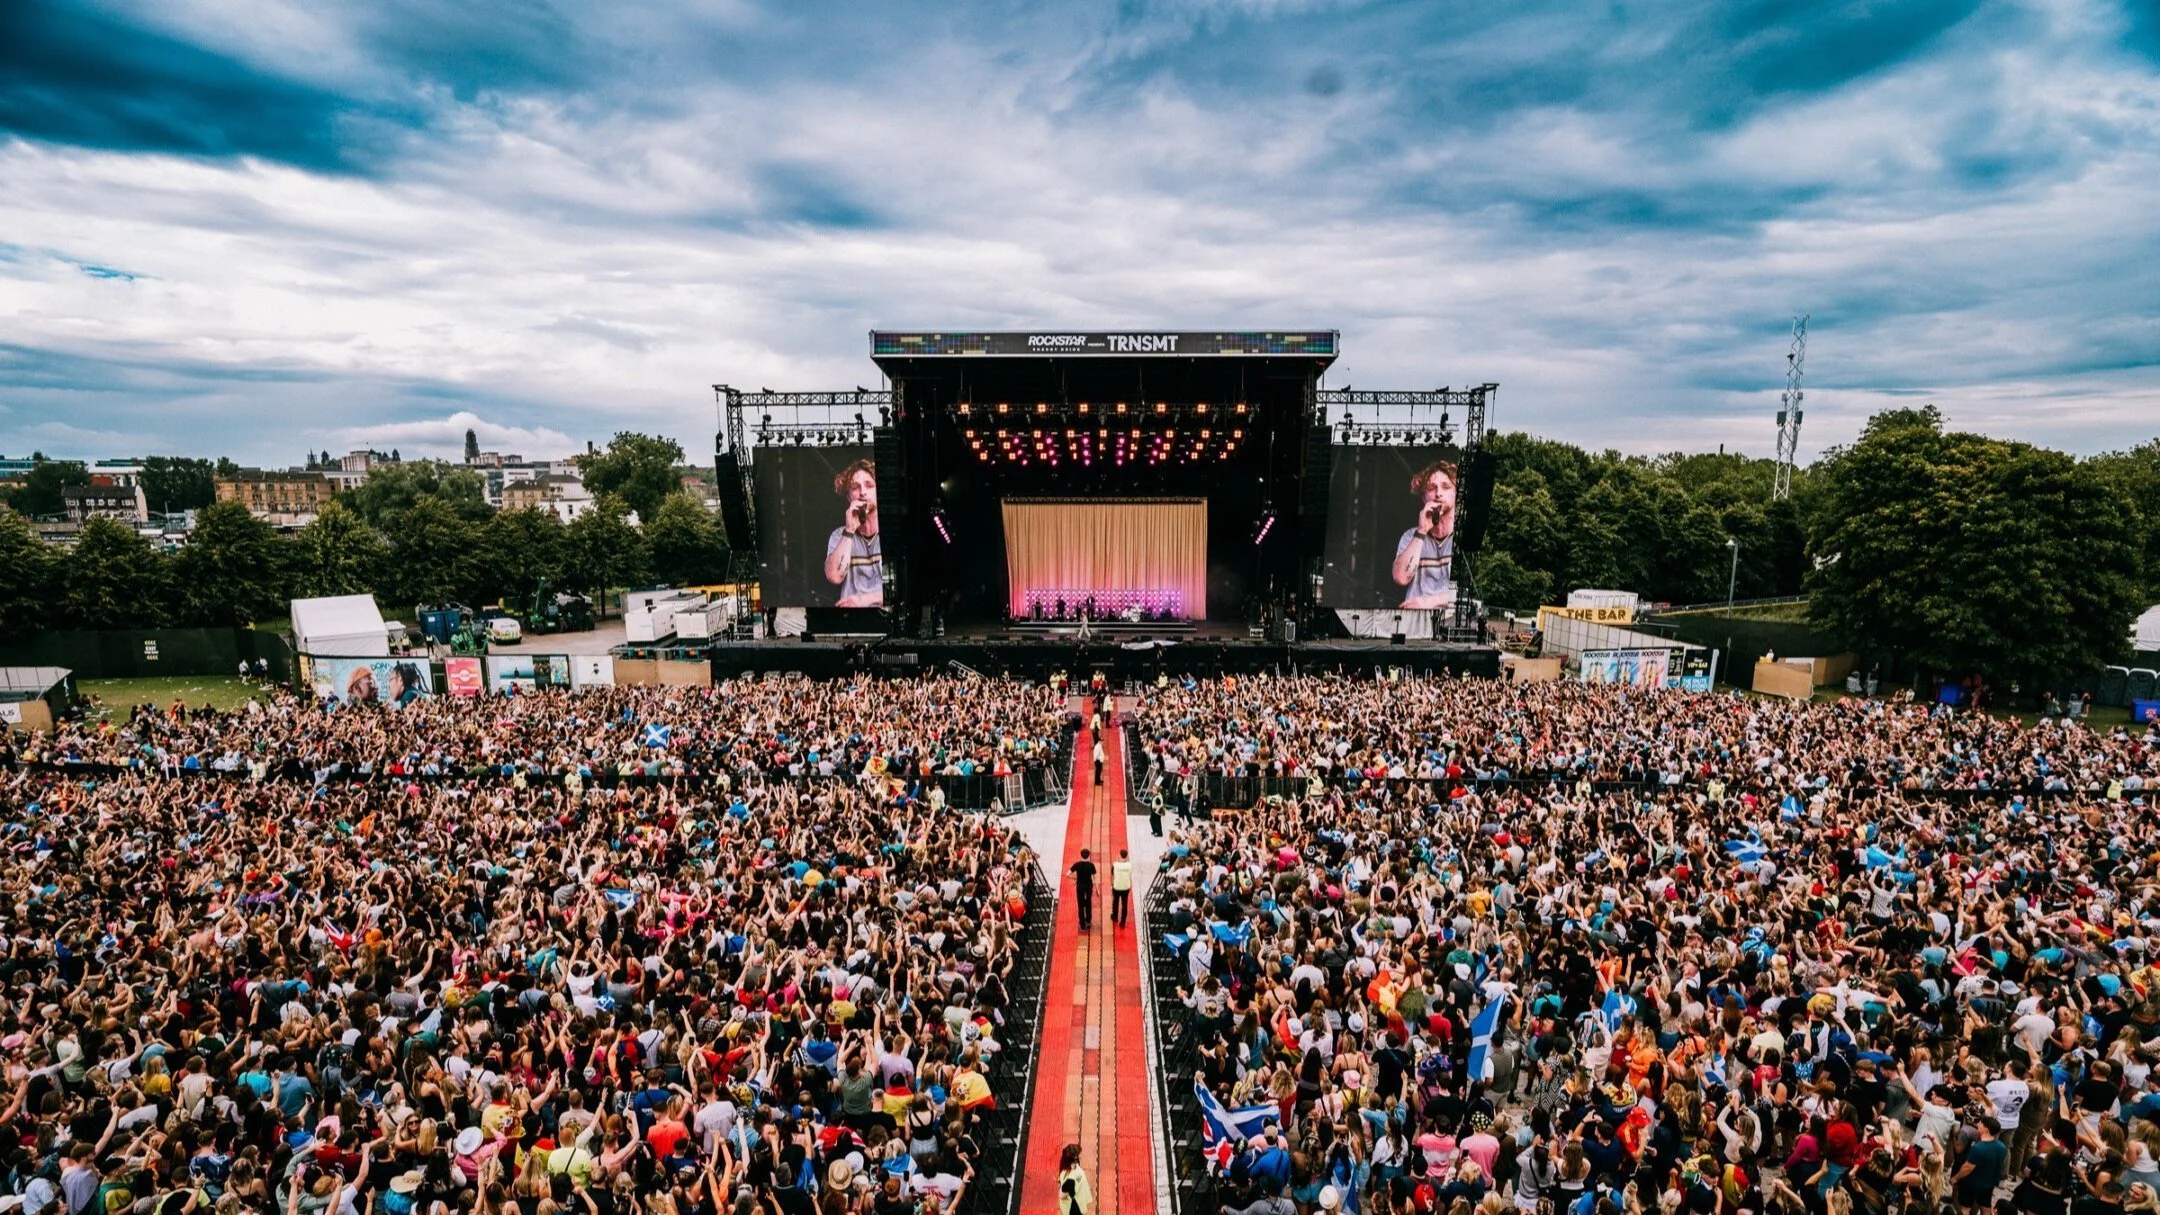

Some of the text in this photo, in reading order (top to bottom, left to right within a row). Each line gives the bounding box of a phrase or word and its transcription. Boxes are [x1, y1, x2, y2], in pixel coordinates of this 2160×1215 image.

[1028, 335, 1087, 346] ROCKSTAR
[1107, 335, 1178, 351] TRNSMT
[1566, 608, 1593, 620] THE
[1597, 609, 1627, 620] BAR
